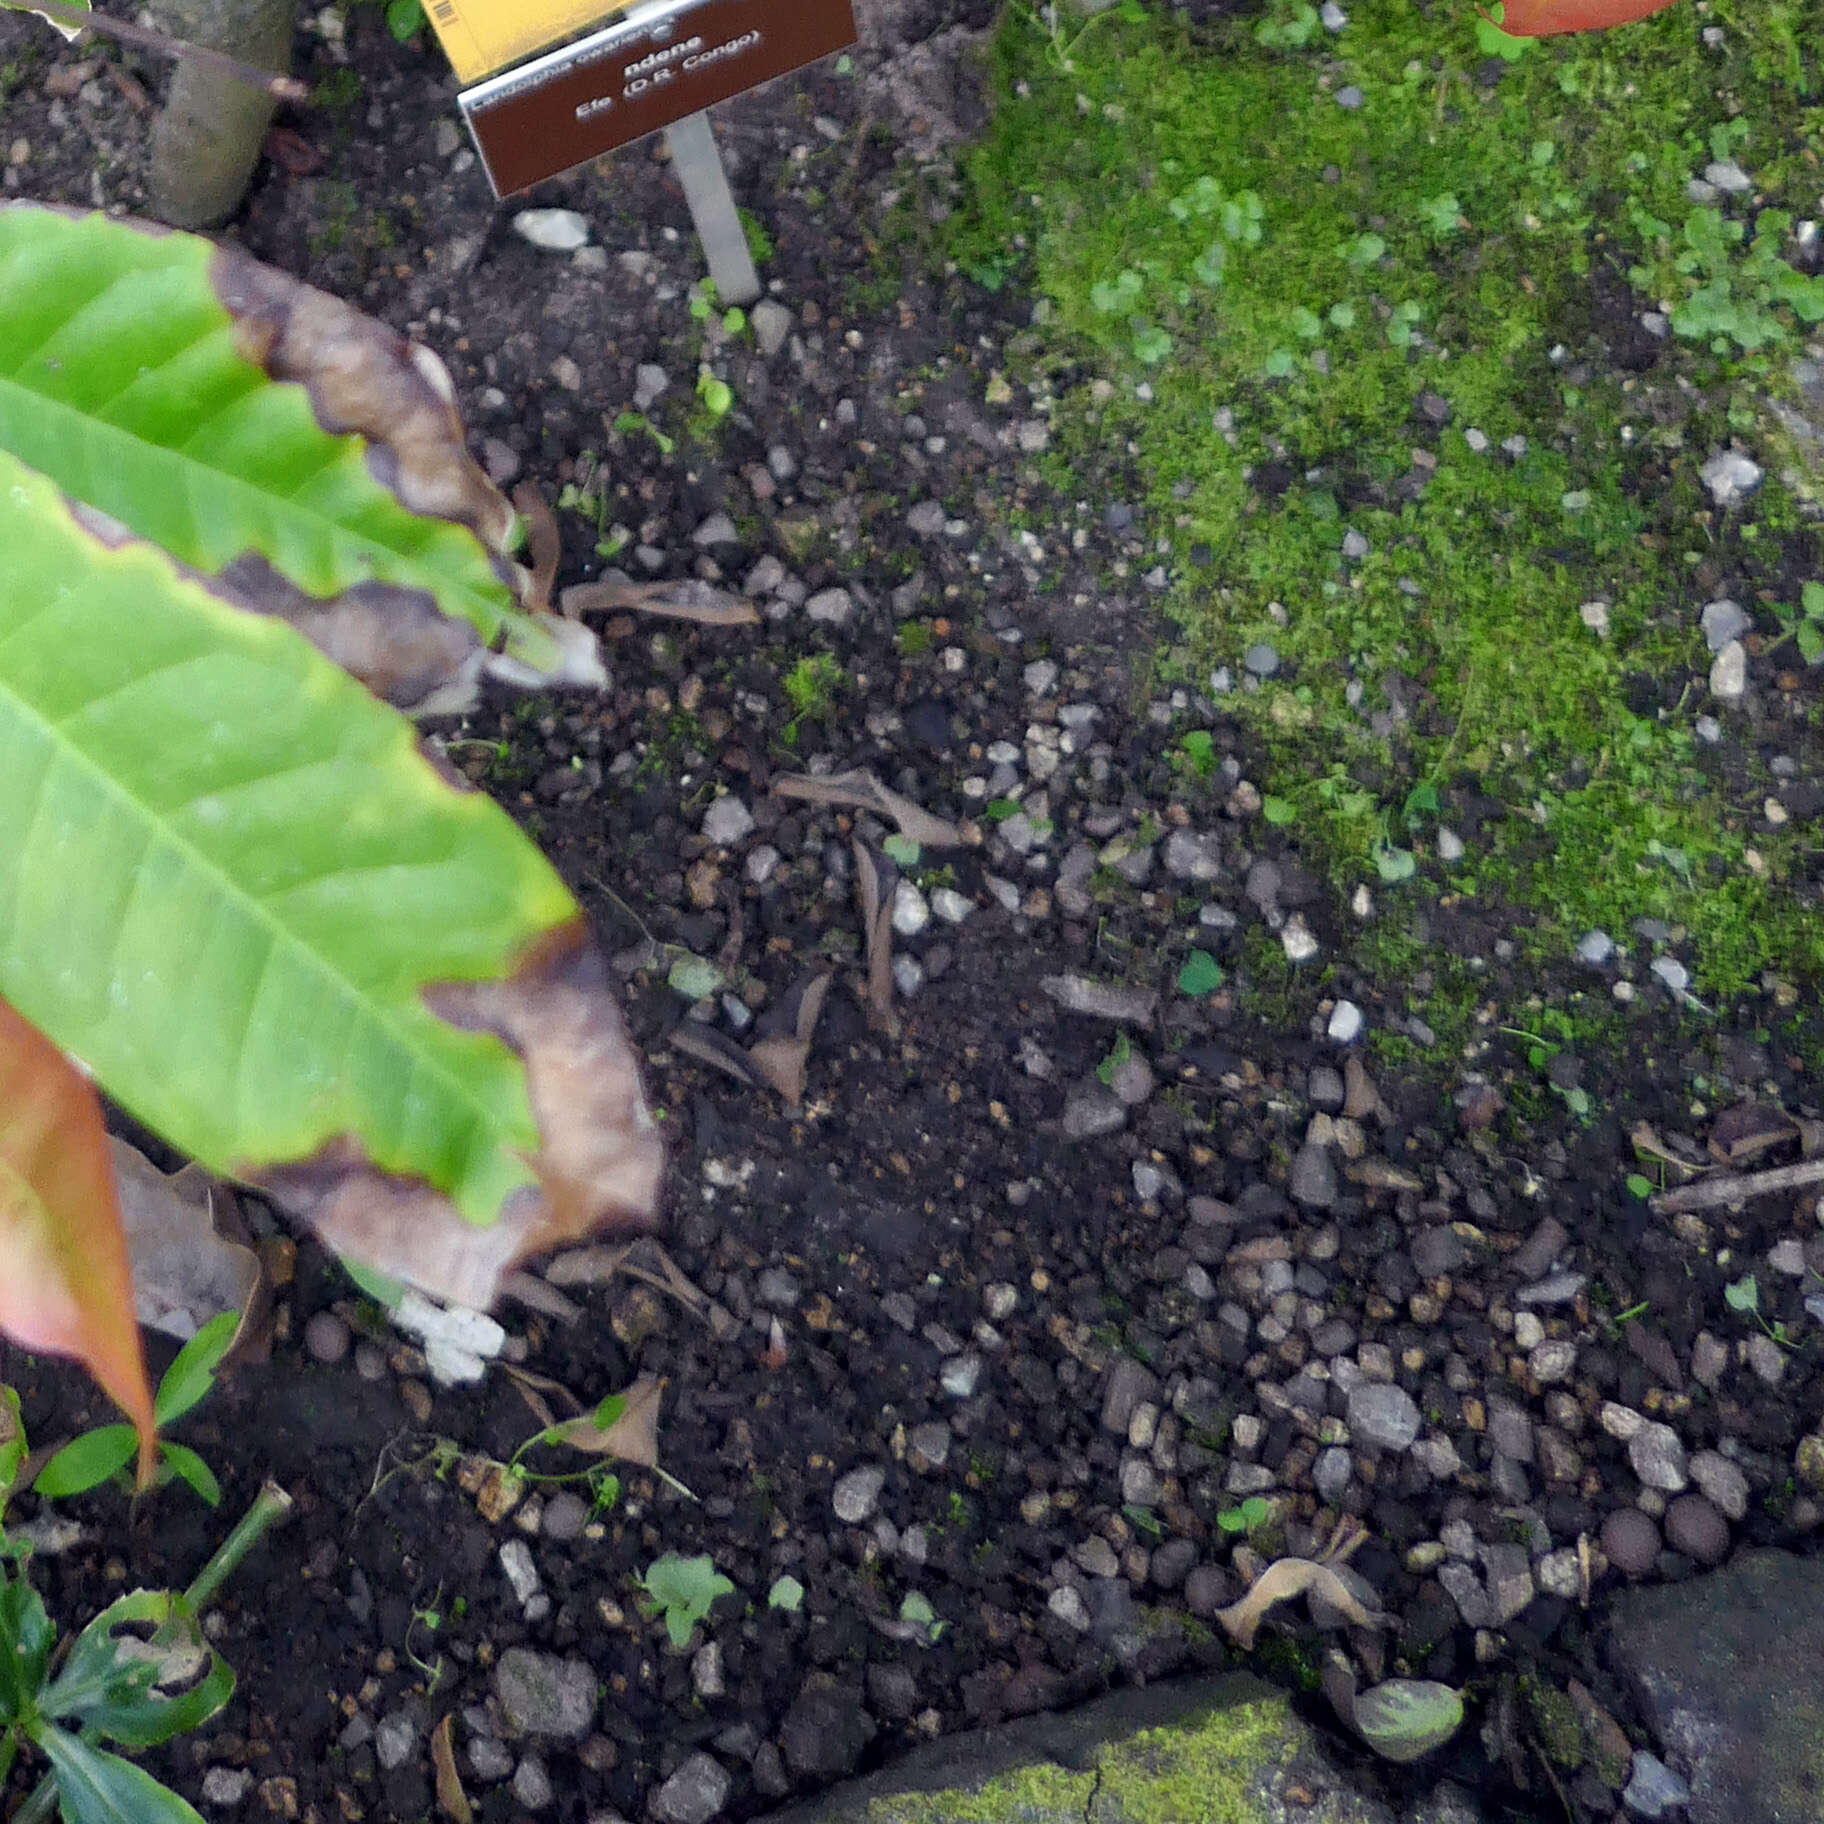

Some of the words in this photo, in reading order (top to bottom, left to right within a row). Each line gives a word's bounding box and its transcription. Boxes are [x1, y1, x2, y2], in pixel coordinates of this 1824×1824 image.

[575, 95, 612, 119] Efe
[682, 29, 760, 69] Congo)
[623, 35, 703, 76] ndene
